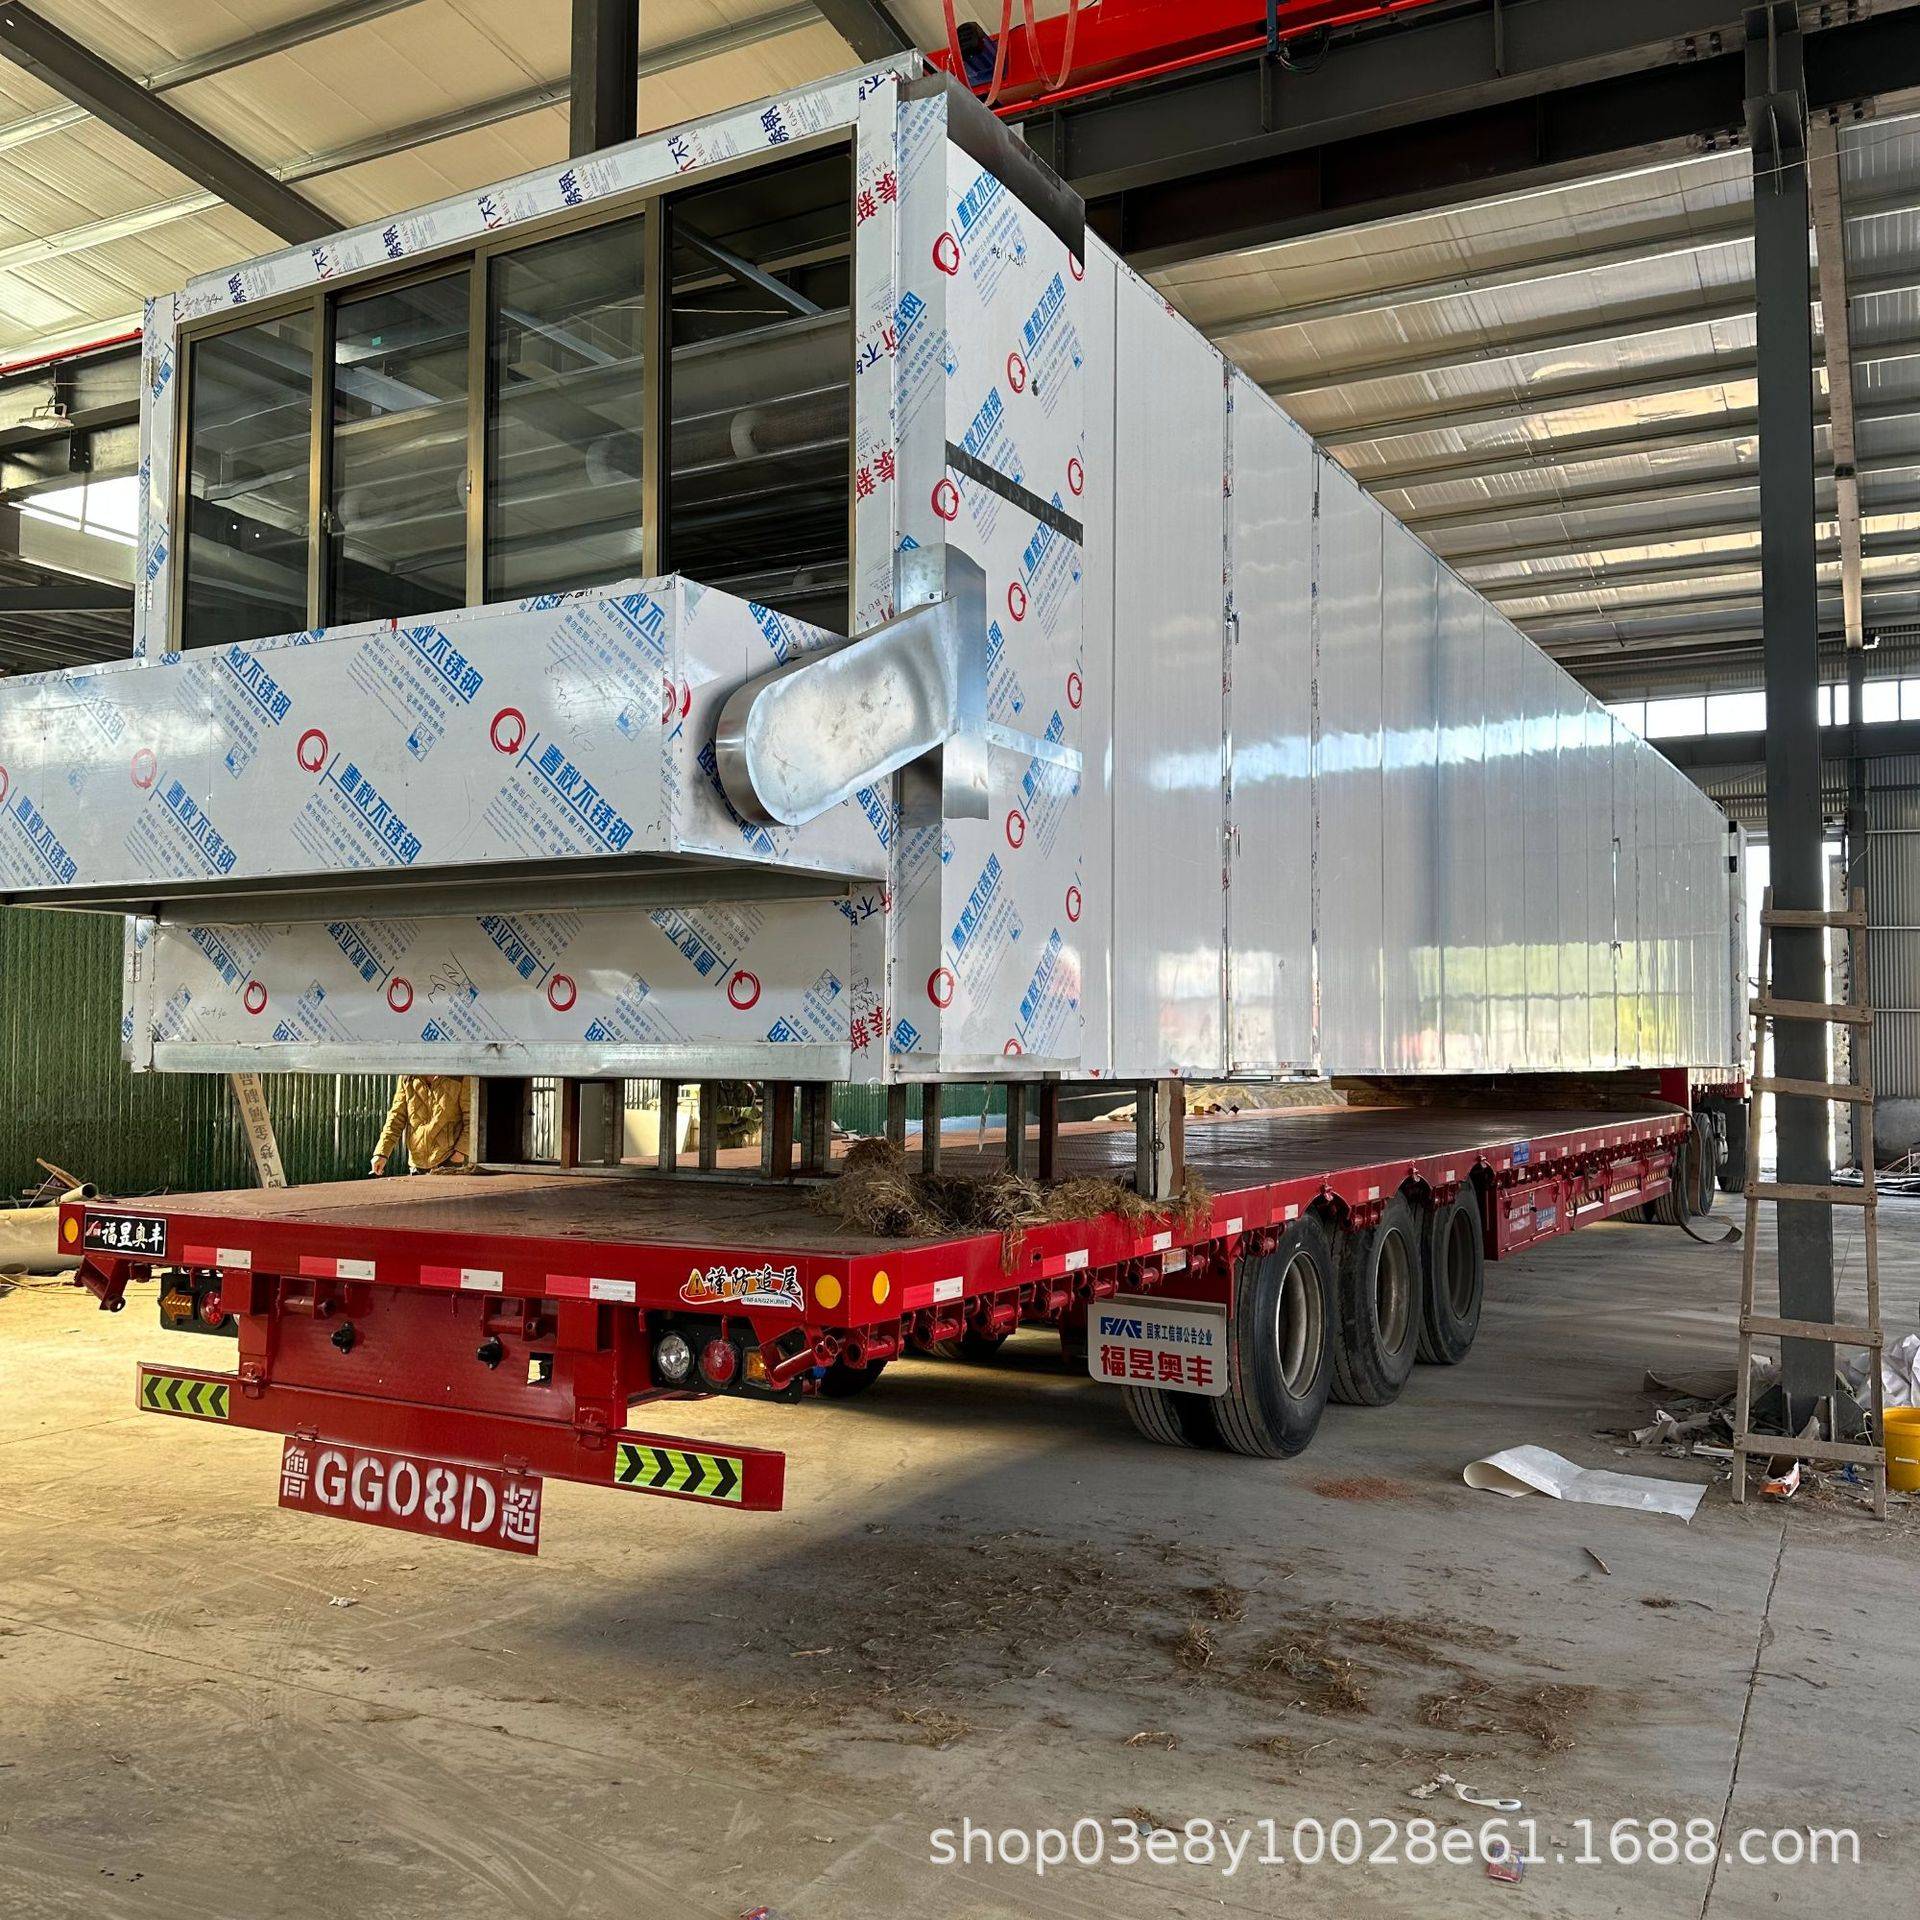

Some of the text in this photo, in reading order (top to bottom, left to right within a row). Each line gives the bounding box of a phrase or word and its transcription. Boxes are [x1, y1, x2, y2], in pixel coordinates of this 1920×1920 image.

[539, 744, 634, 852] 春秋不锈钢
[101, 1221, 163, 1252] 福昱奥丰
[1100, 1344, 1213, 1387] 福昱奥丰
